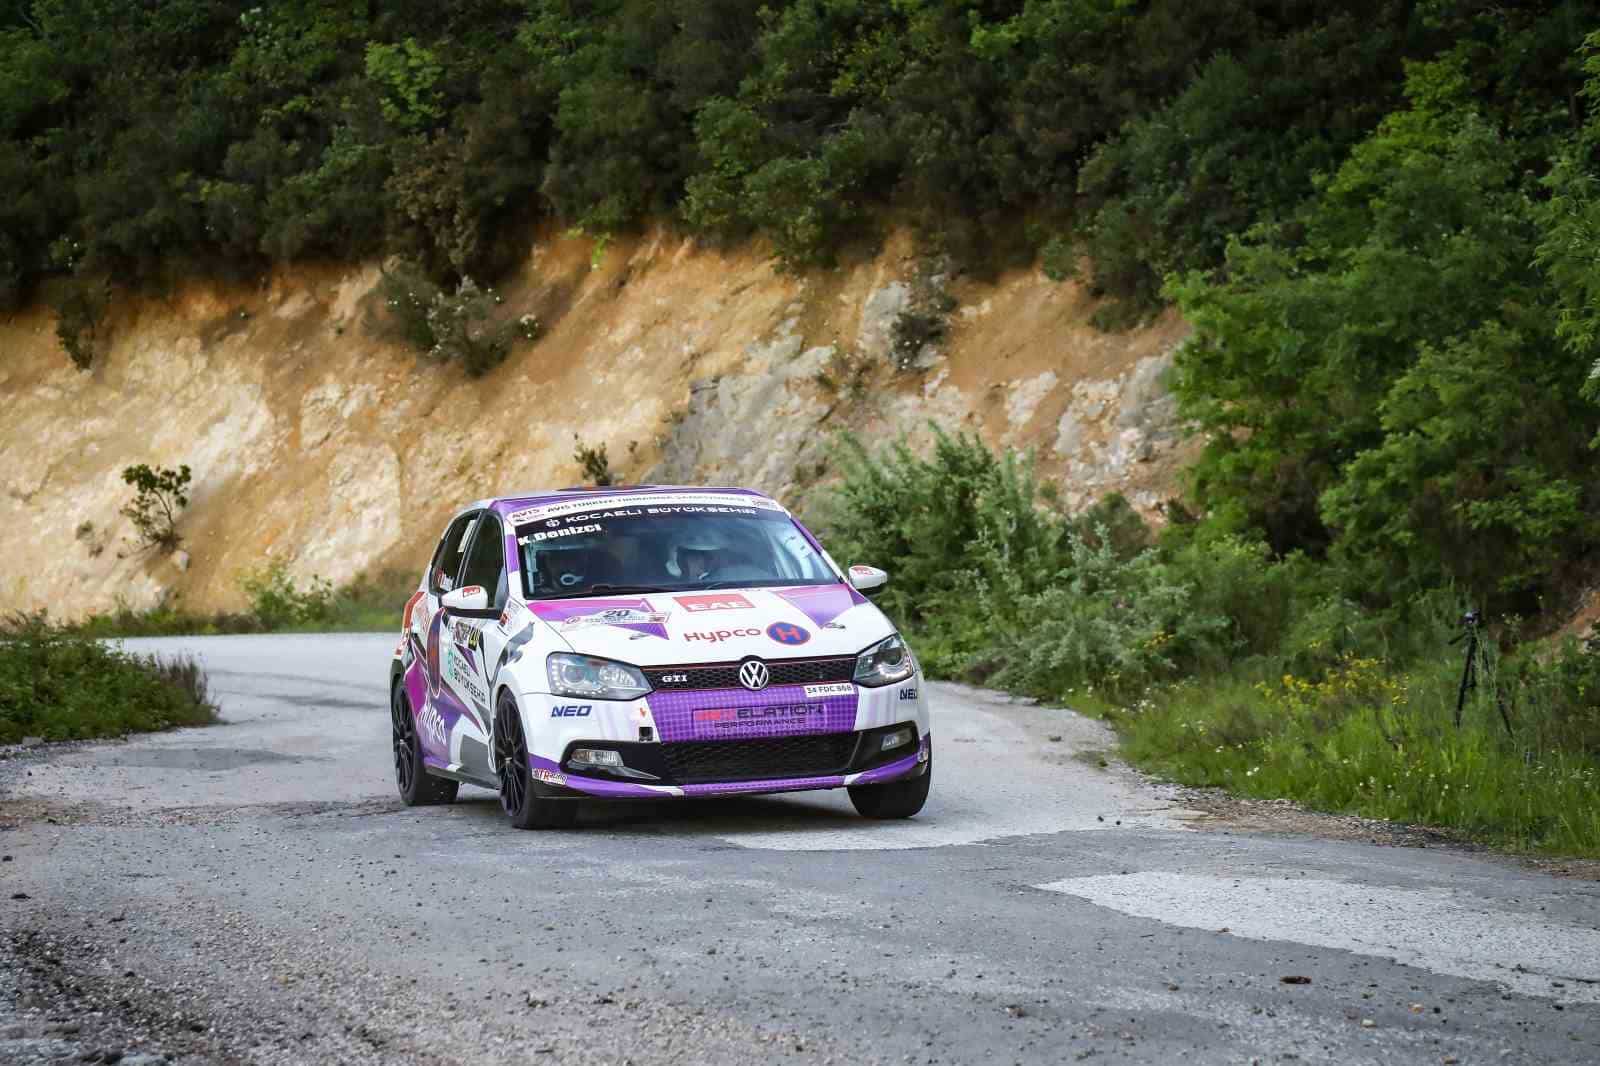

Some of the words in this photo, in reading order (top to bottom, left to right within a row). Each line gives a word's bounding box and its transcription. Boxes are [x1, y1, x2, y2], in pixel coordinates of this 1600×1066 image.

[683, 628, 762, 643] Hypco
[662, 674, 688, 683] GTI
[551, 705, 593, 718] NEO
